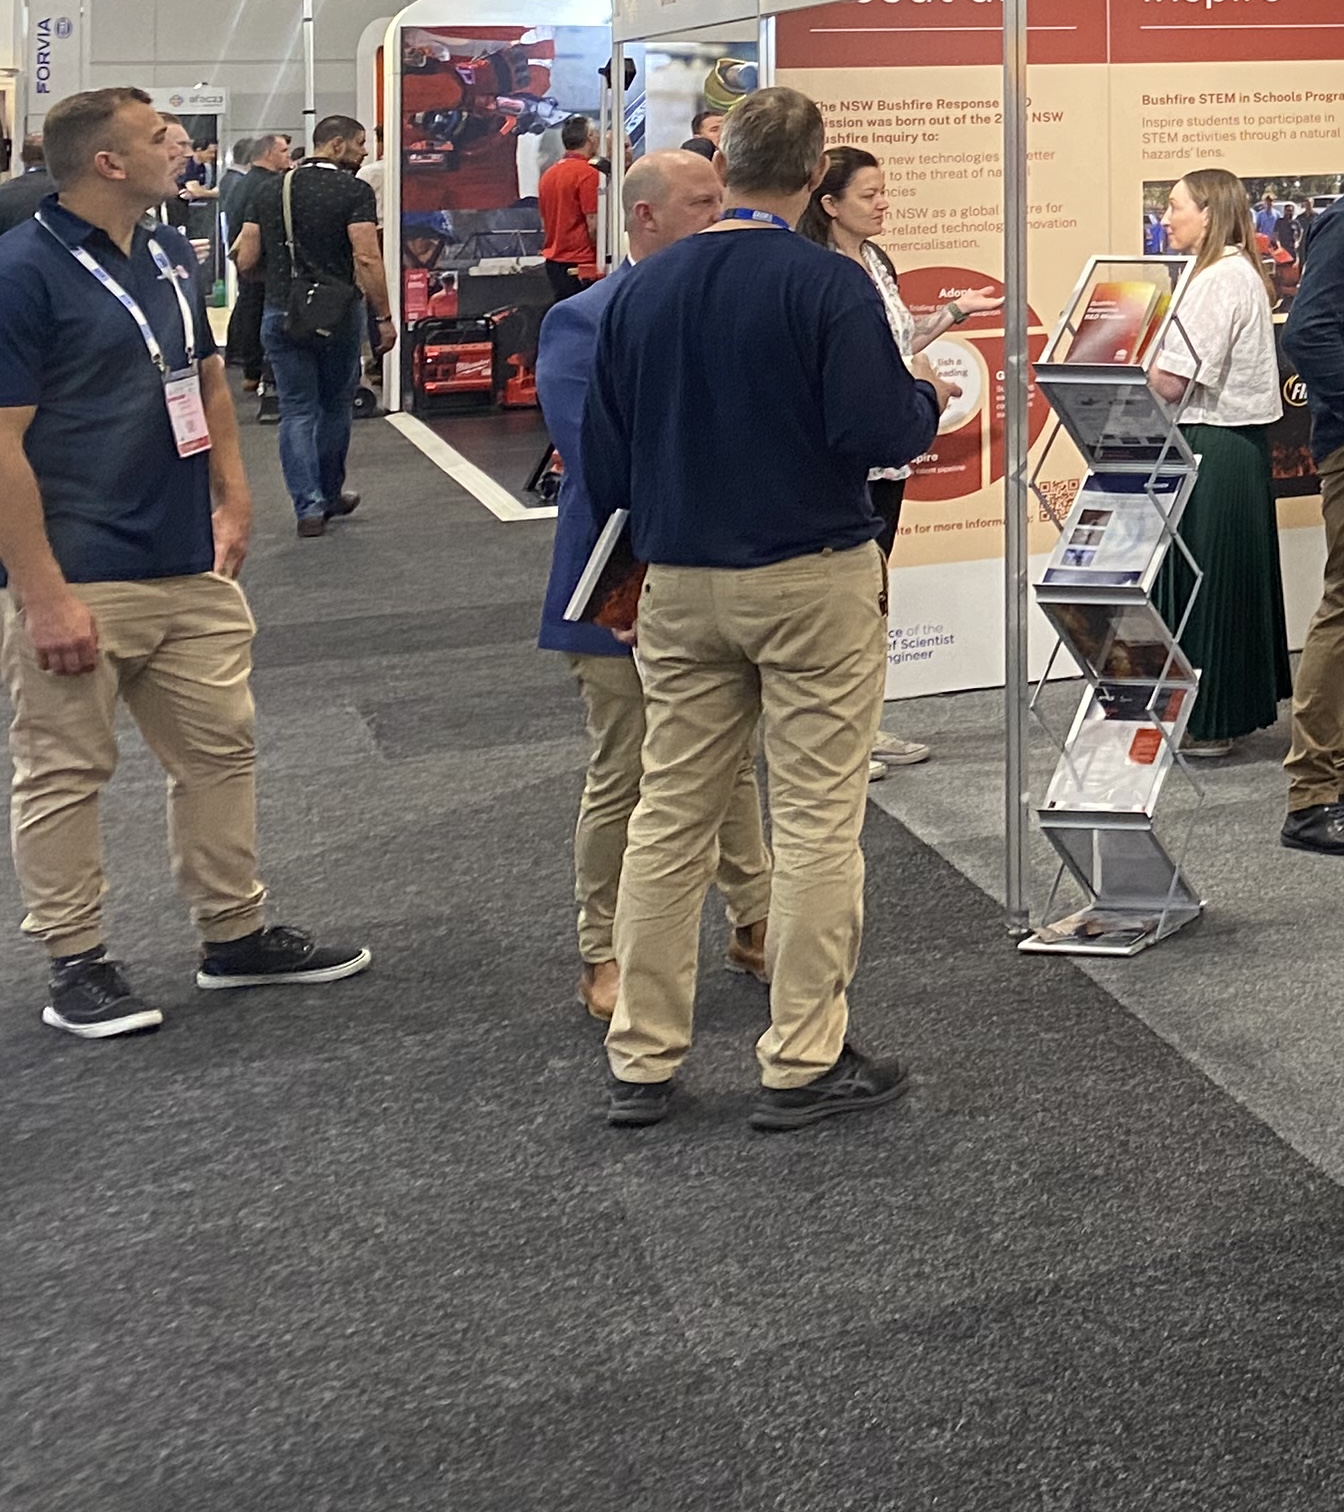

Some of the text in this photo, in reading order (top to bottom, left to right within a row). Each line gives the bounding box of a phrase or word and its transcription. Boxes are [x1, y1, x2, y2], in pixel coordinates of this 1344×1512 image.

[37, 18, 51, 93] FORVIA
[840, 100, 873, 111] NSW
[877, 99, 933, 111] Bushfire
[936, 99, 999, 112] Response
[1142, 94, 1196, 106] Bushfire
[1199, 93, 1236, 104] STEM
[1239, 93, 1250, 103] in
[1253, 91, 1302, 103] Schools
[824, 112, 1064, 128] ission was born out of the NSW
[1142, 113, 1335, 129] Inspire students to participate in
[824, 131, 939, 147] ushfire Inquiry to:
[1142, 128, 1341, 144] STEM activities through a natural
[919, 151, 999, 167] technologies
[1197, 147, 1225, 158] lens.
[906, 170, 926, 181] the
[930, 168, 967, 180] threat
[972, 167, 984, 178] of
[896, 207, 928, 219] NSW
[932, 209, 946, 218] as
[960, 205, 999, 219] global
[1045, 203, 1063, 213] for
[942, 221, 1004, 235] technolog
[934, 522, 963, 532] more
[901, 634, 955, 650] Scientist
